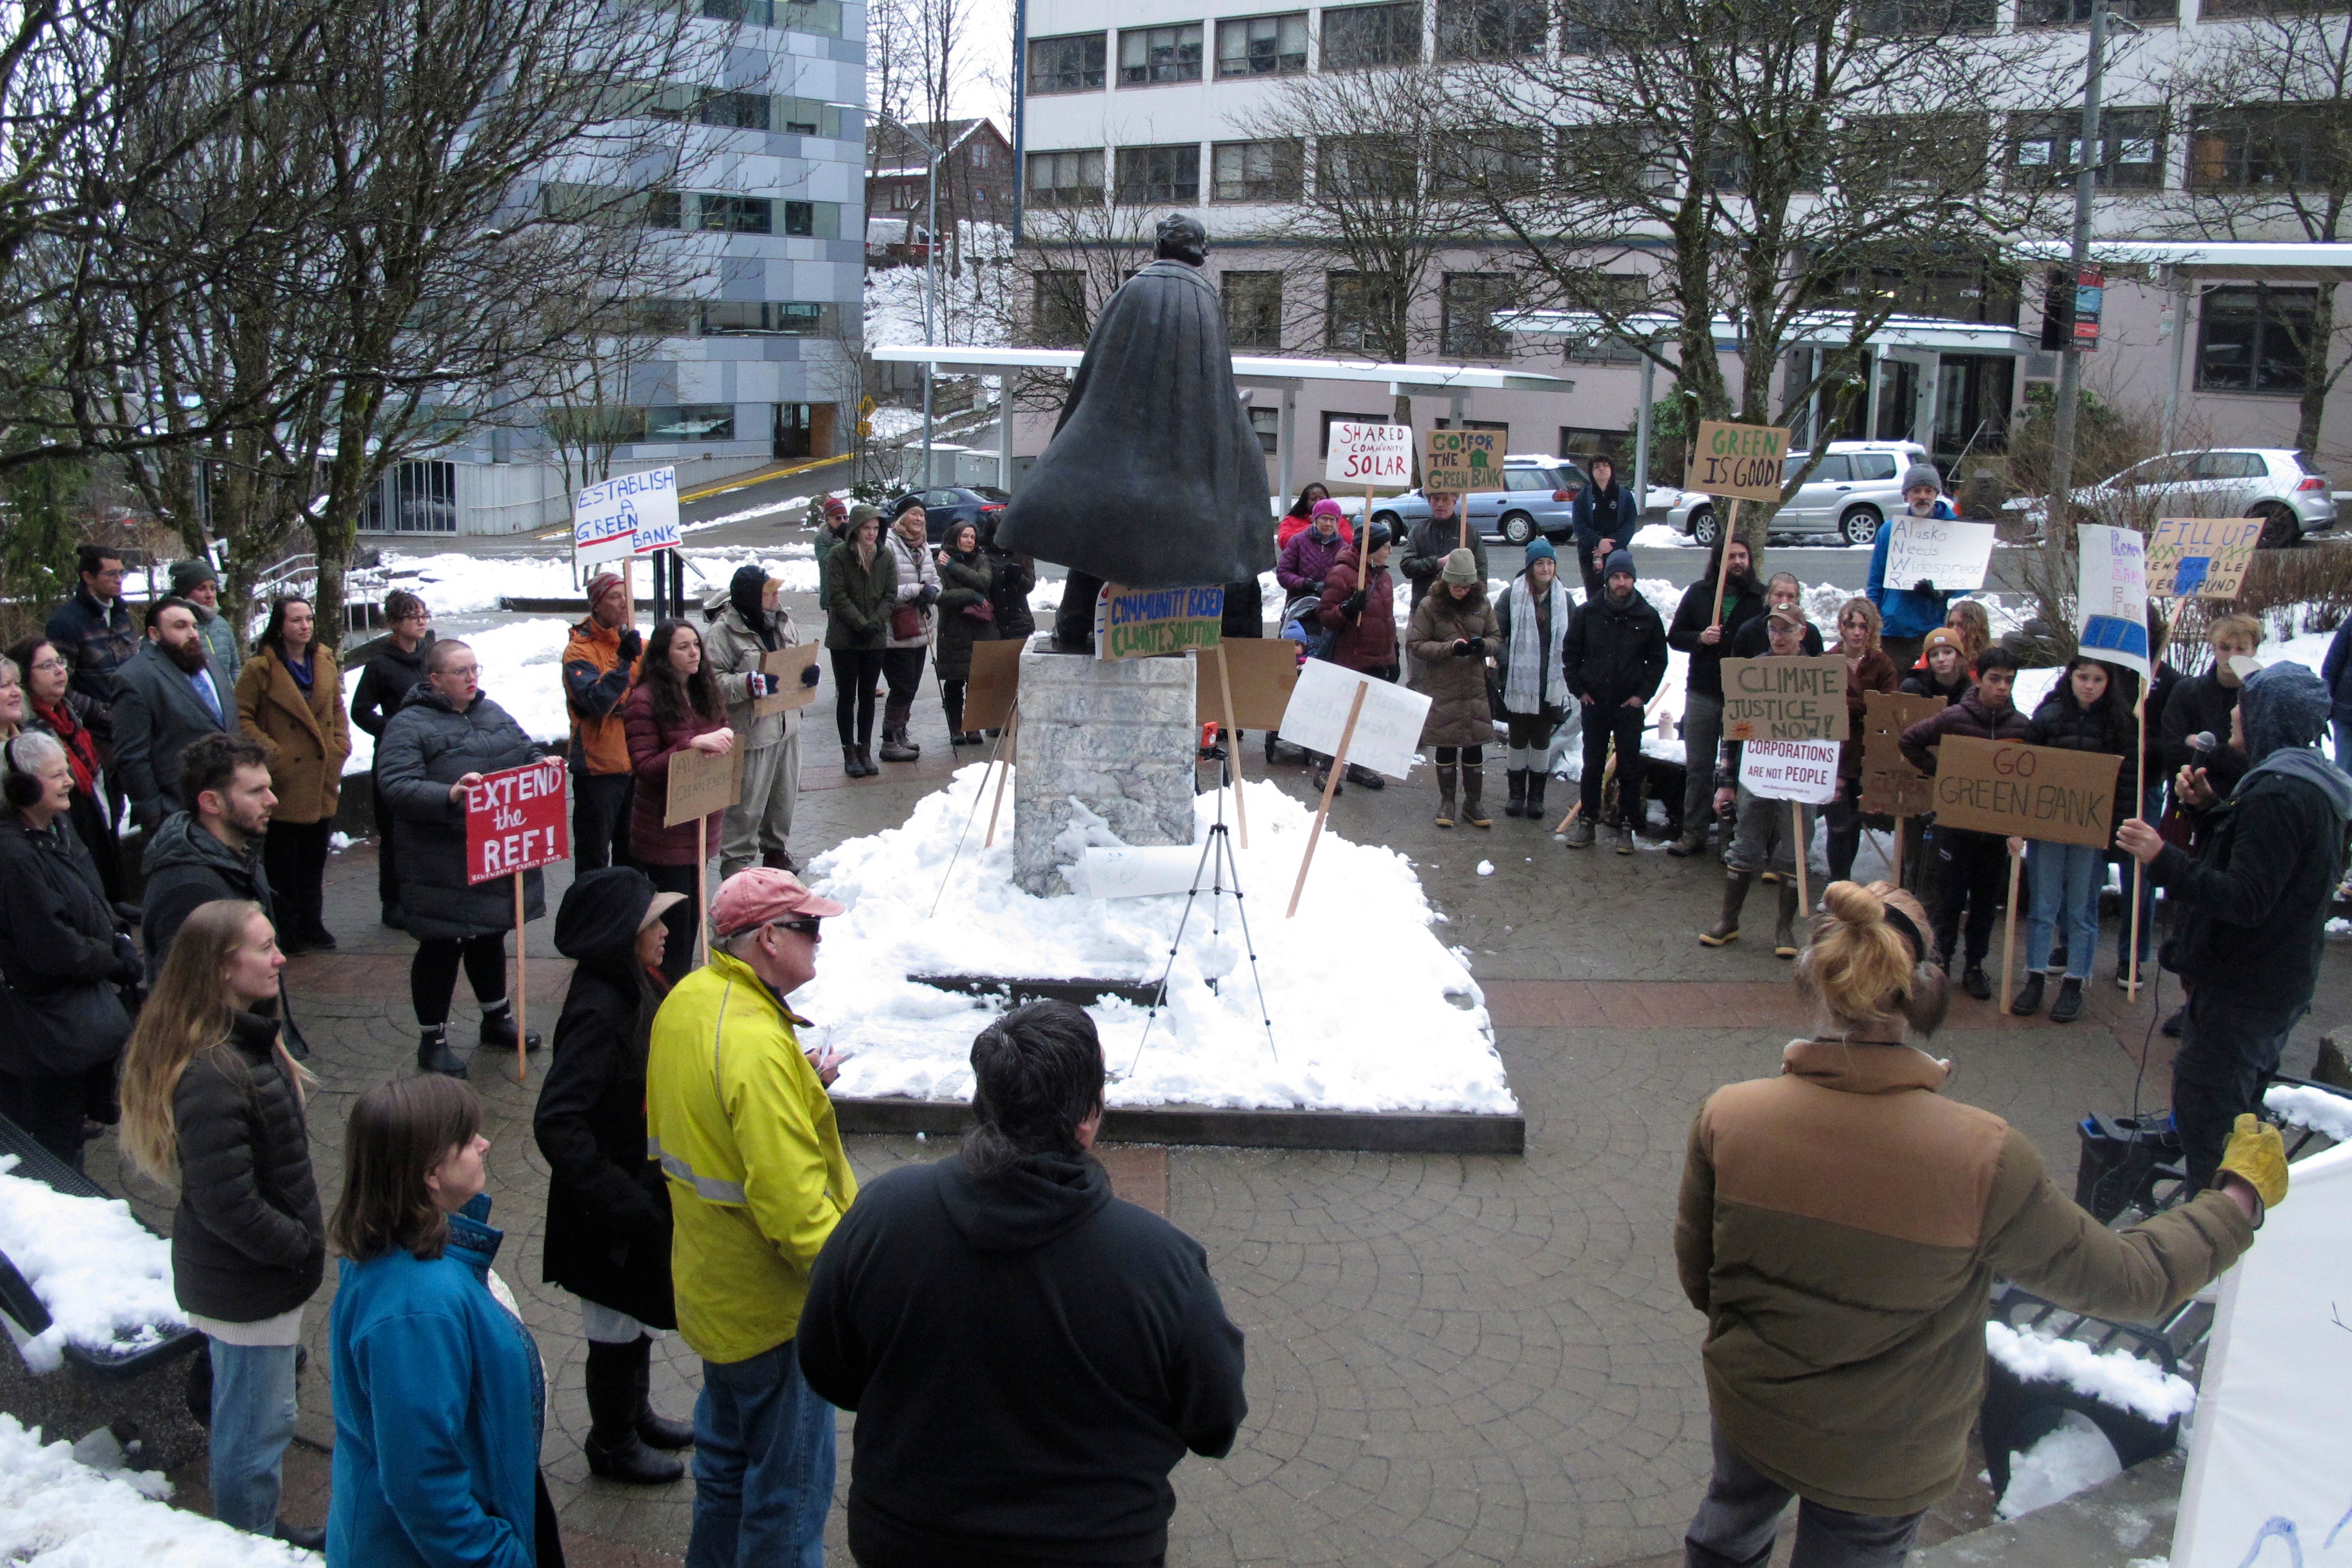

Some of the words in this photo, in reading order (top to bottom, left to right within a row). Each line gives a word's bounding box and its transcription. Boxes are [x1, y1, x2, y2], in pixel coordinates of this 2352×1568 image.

[1340, 424, 1404, 444] SHARED
[1467, 435, 1494, 451] FOR
[1712, 429, 1779, 456] GREEN
[1351, 443, 1404, 452] COMMUNITY
[1344, 455, 1406, 477] SOLAR
[1428, 453, 1458, 467] THE
[1427, 470, 1467, 489] GREEN
[1471, 467, 1502, 488] BANK
[1702, 456, 1732, 484] IS
[1734, 458, 1783, 489] GOOD!
[578, 470, 674, 509] ESTABLISH
[621, 499, 634, 516] A
[576, 513, 638, 541] GREEN
[632, 525, 678, 548] BANK
[1893, 520, 1946, 542] Alaska
[2154, 521, 2213, 547] FILL
[2222, 524, 2259, 547] UP
[1892, 540, 1939, 556] Needs
[1890, 556, 1983, 575] Widespread
[2194, 578, 2236, 594] FUND
[1738, 666, 1838, 696] CLIMATE
[1727, 698, 1817, 721] JUSTICE
[1770, 715, 1834, 739] NOW!
[1748, 739, 1834, 763] CORPORATIONS
[1993, 748, 2036, 778] GO
[1748, 765, 1764, 778] ARE
[1766, 767, 1783, 780] NOT
[1785, 766, 1828, 785] PEOPLE
[469, 766, 562, 813] EXTEND
[1939, 776, 2028, 816] GREEN
[2035, 785, 2104, 831] BANK
[493, 806, 527, 831] the
[472, 867, 512, 882] RENEWABLE
[516, 859, 540, 870] ENERGY
[544, 854, 562, 863] FUND
